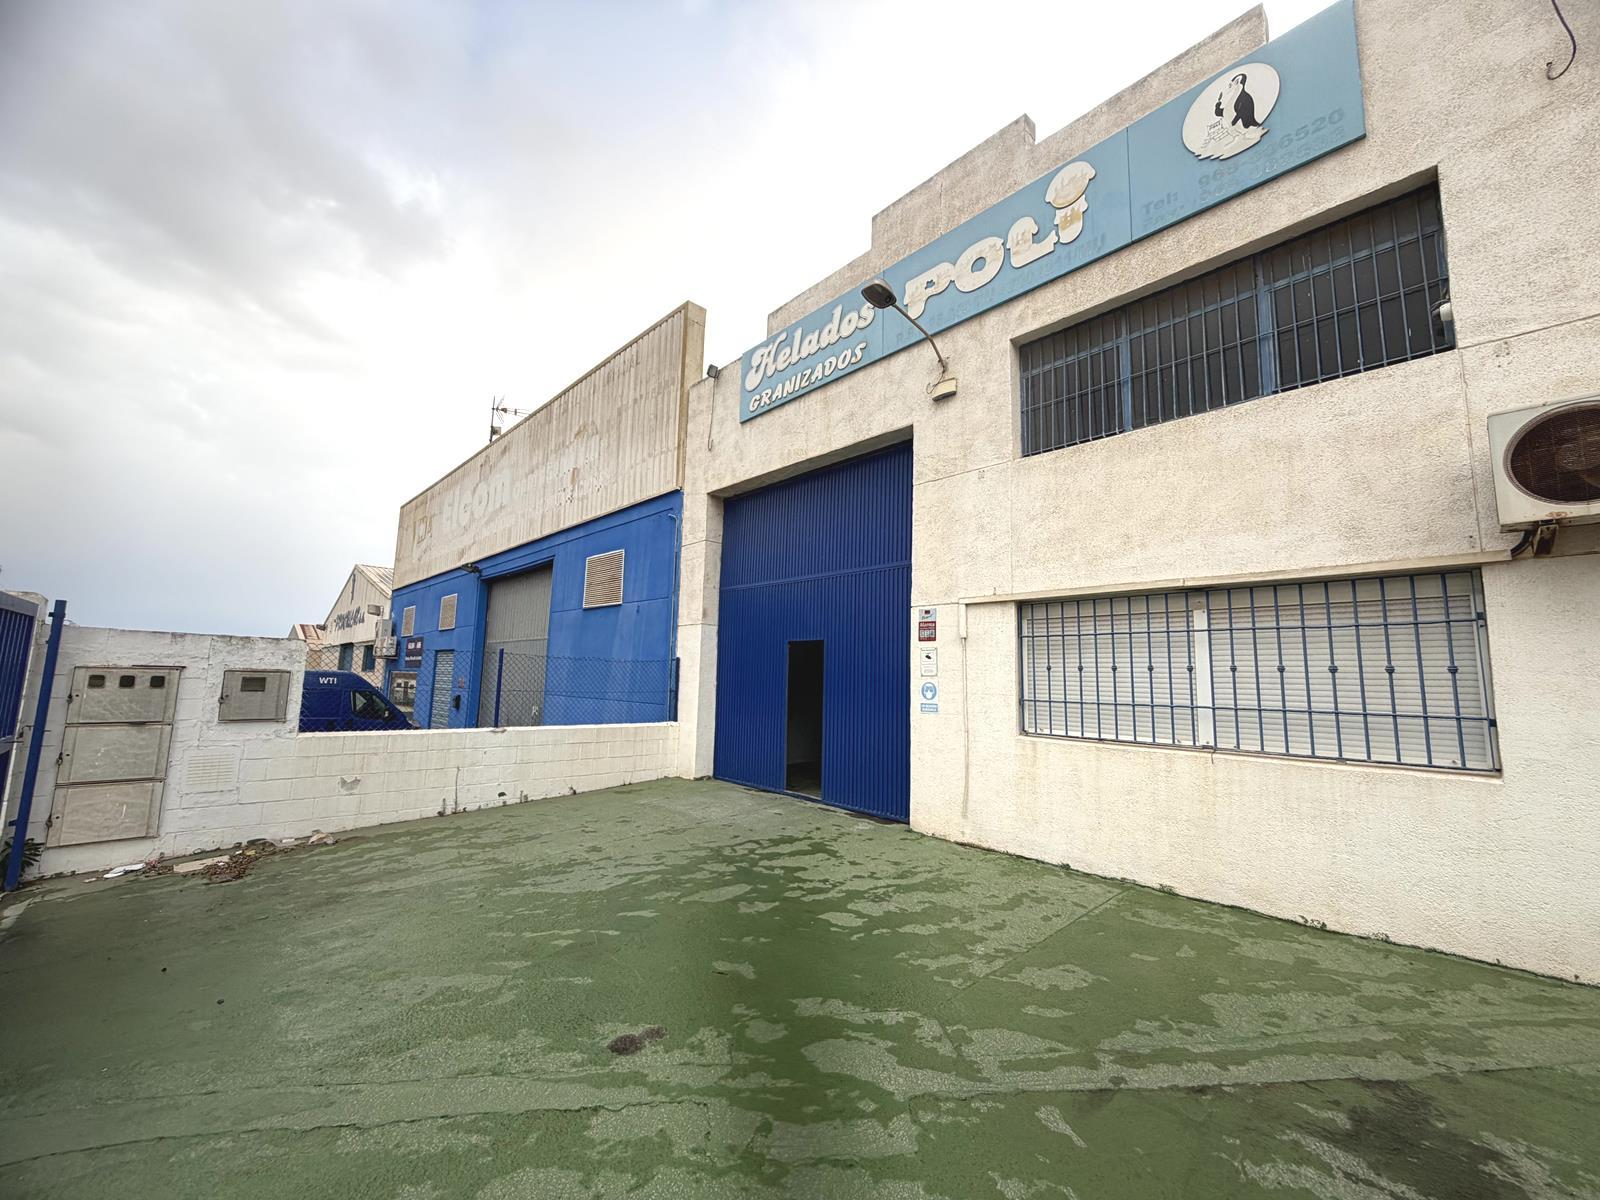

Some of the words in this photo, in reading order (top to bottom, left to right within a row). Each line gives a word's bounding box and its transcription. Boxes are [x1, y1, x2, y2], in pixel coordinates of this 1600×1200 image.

[744, 303, 875, 392] Helados
[748, 341, 867, 412] GRANIZADOS
[319, 676, 337, 685] WTI
